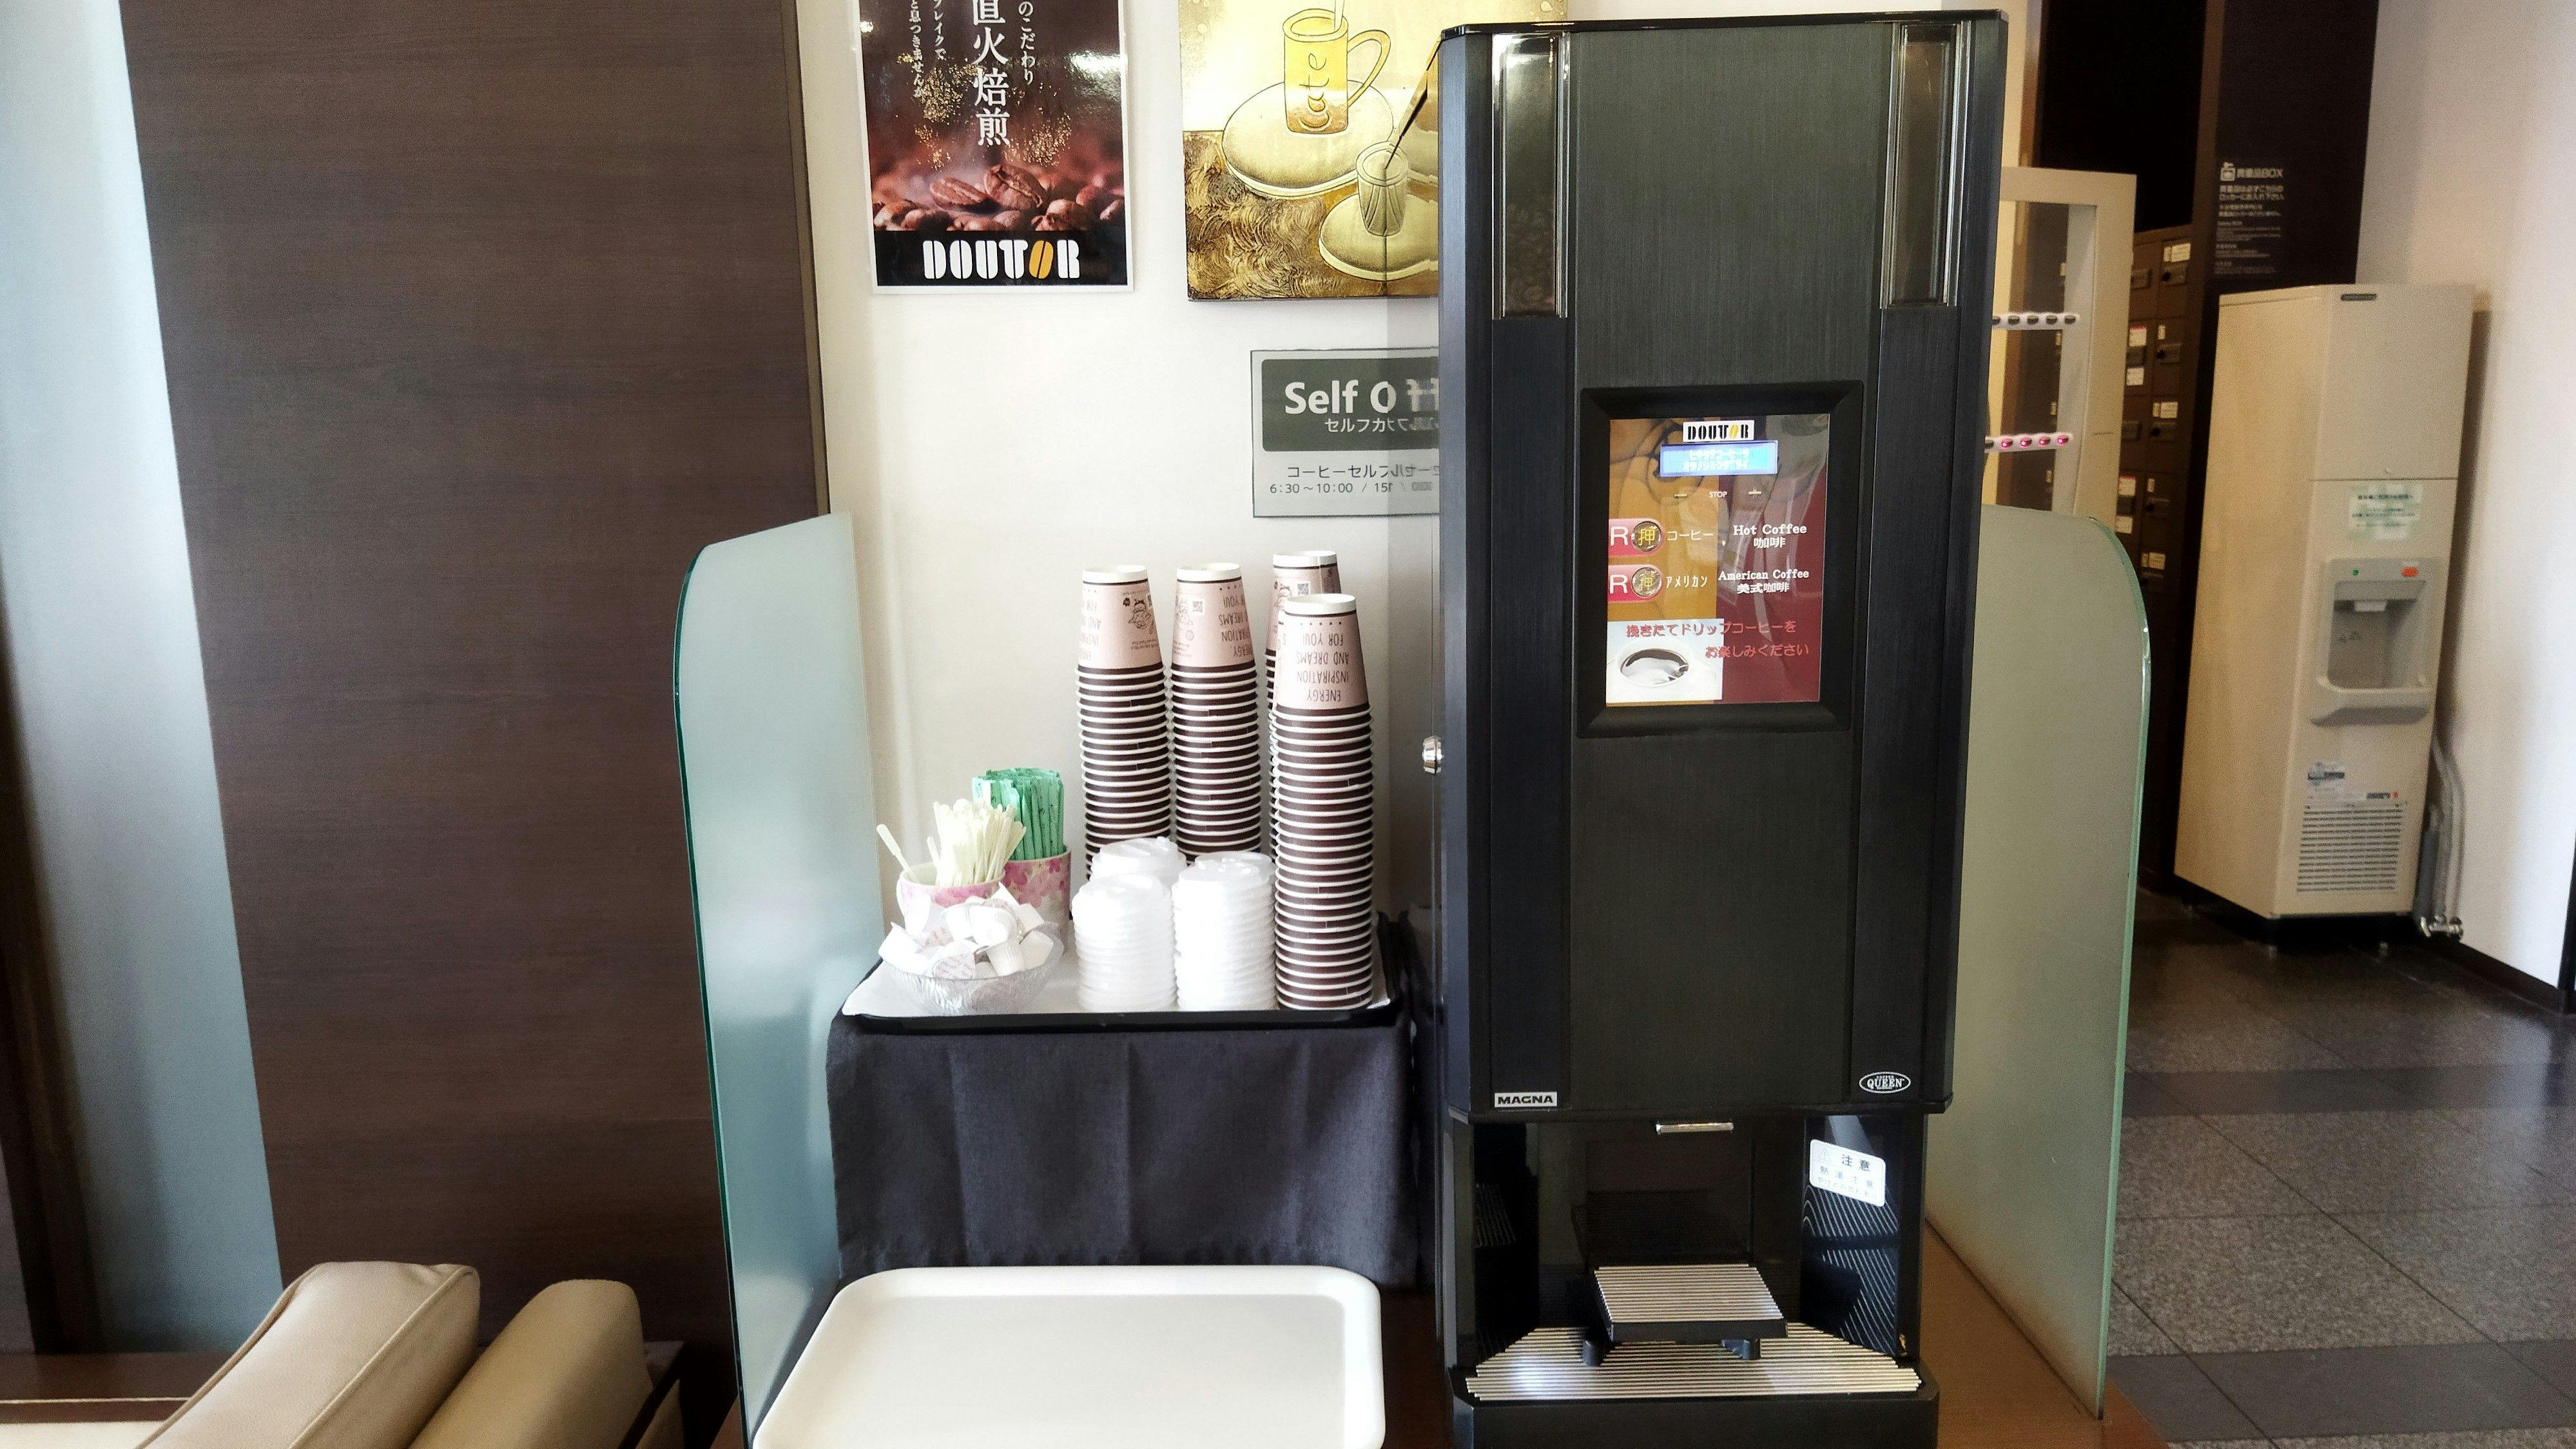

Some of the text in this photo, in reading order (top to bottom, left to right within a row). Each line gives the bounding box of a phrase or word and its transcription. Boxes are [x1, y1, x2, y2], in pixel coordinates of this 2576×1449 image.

[971, 0, 1011, 148] 直火焙煎
[923, 240, 1080, 280] DOUTOR
[1285, 379, 1359, 414] Self
[1687, 424, 1749, 440] DOUTOR
[1610, 526, 1629, 546] R
[1667, 529, 1714, 541] コーヒー
[1733, 523, 1807, 536] Hot Coffee
[1638, 528, 1656, 546] 押
[1666, 575, 1709, 588] アメリカン
[1718, 569, 1810, 581] American Coffee
[1609, 574, 1629, 594] R
[1626, 620, 1797, 637] 挽きたてドリップコーヒーを
[1329, 633, 1344, 646] FOR
[1296, 651, 1350, 665] AND DREAMS
[1705, 644, 1810, 658] お楽しみください
[1297, 670, 1350, 684] INSPIRATION
[1866, 1077, 1904, 1090] QUEEN
[1497, 1095, 1554, 1105] MAGNA
[1841, 1153, 1870, 1172] 注意
